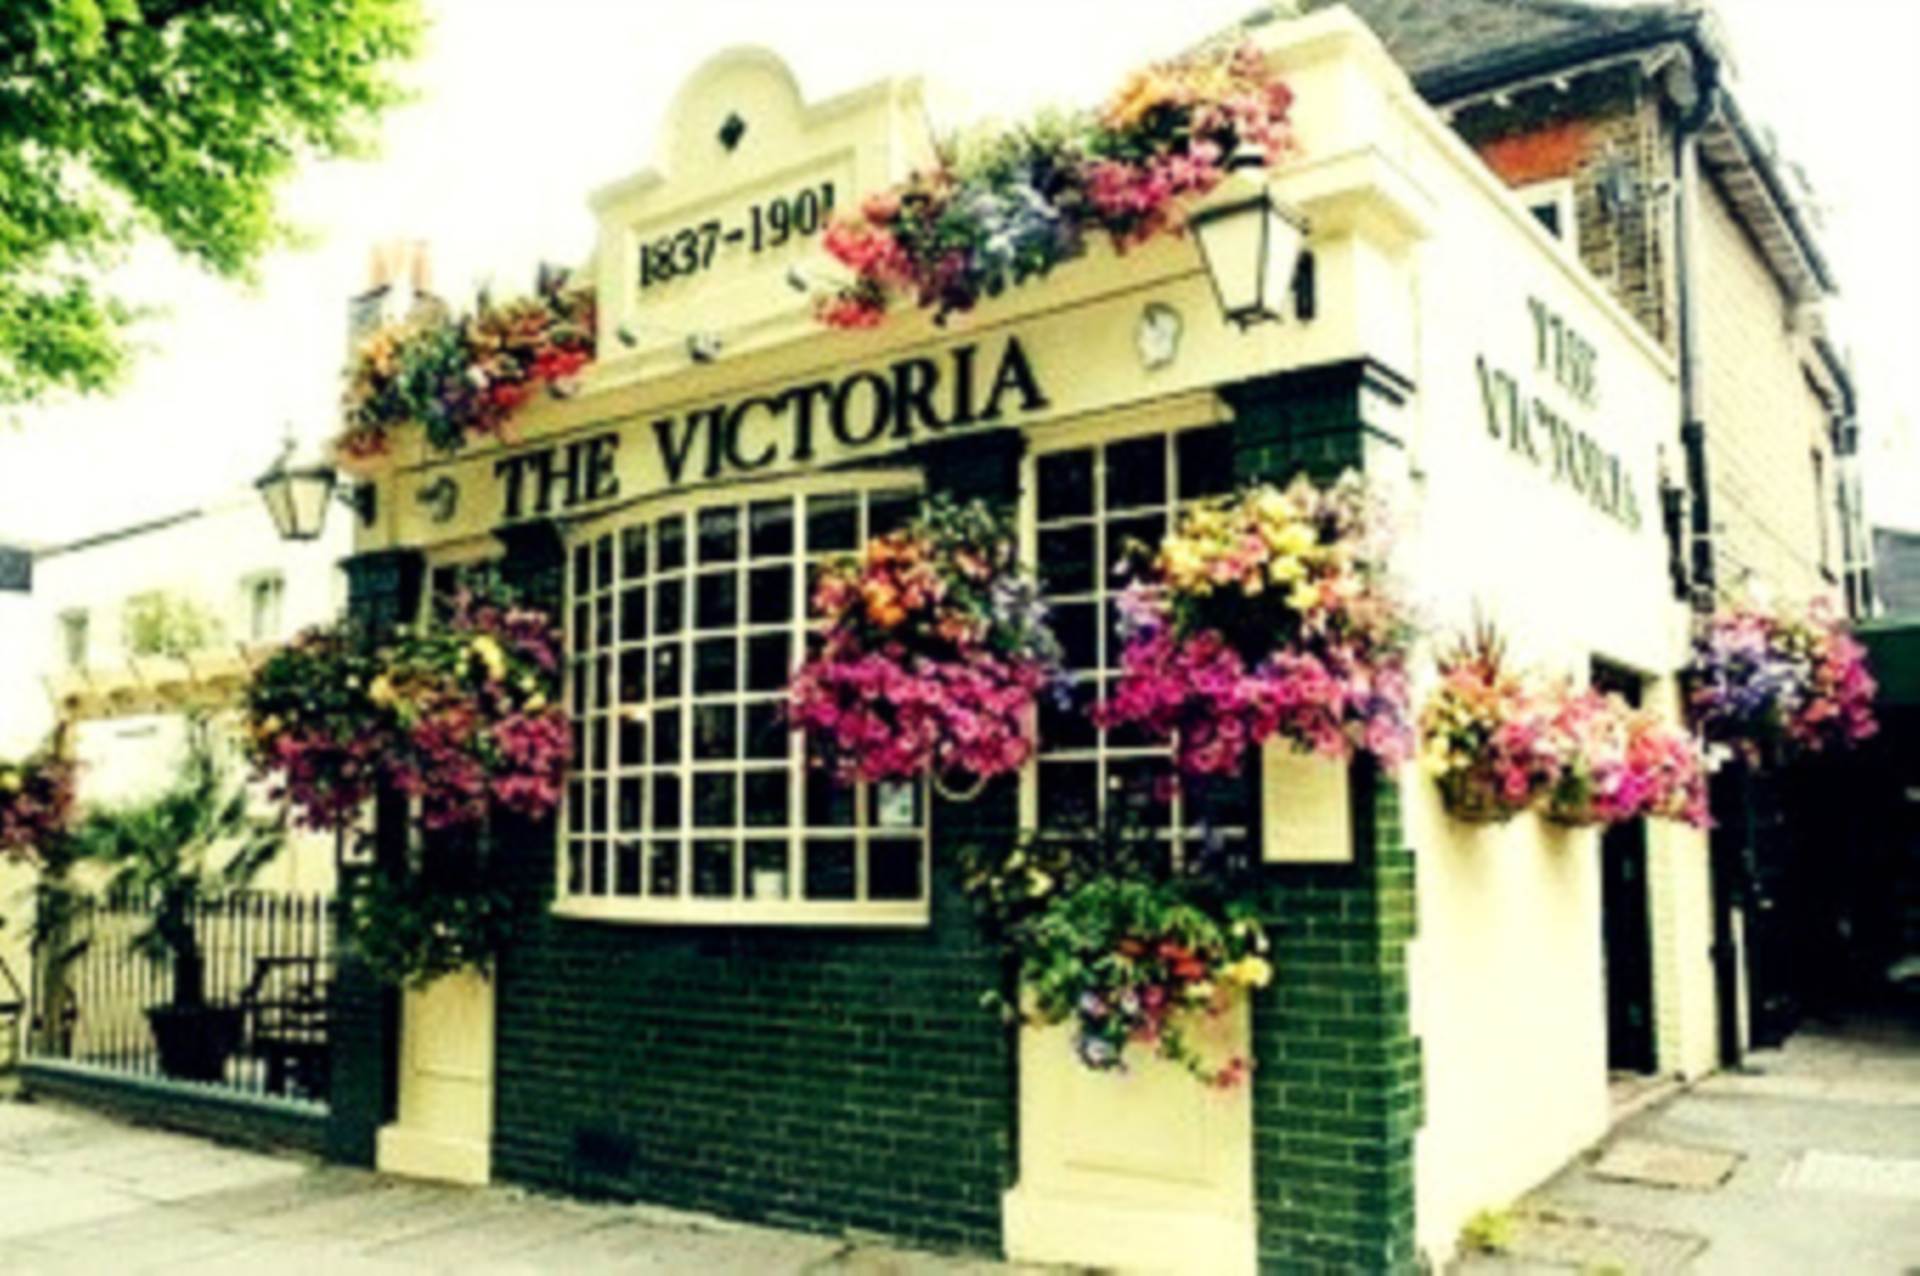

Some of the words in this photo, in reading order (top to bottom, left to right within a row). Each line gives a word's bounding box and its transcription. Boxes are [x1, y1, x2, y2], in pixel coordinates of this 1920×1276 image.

[496, 432, 620, 517] THE
[653, 336, 1050, 483] VICTORIA
[1527, 296, 1598, 408] THE
[1476, 353, 1642, 531] VICTORIA
